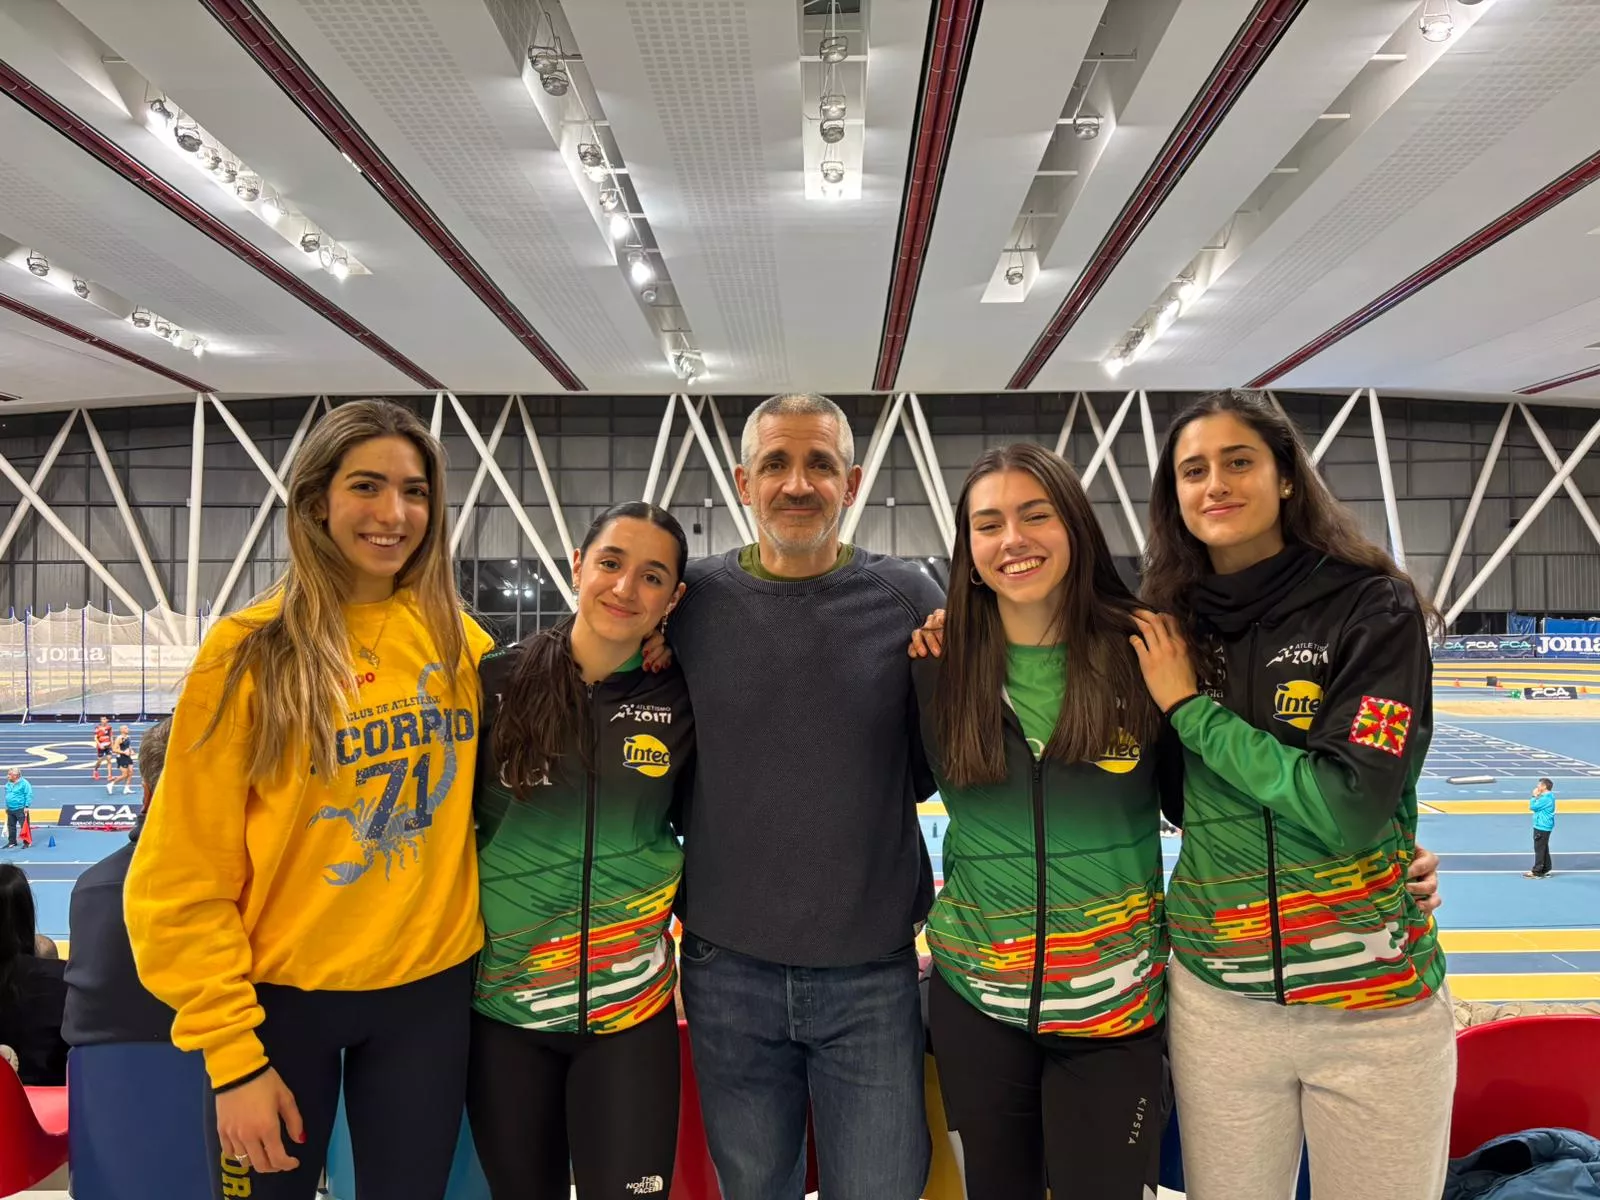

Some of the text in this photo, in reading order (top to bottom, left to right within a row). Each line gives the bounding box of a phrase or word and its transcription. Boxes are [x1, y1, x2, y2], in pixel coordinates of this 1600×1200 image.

[1531, 687, 1570, 696] FCA
[376, 703, 389, 714] DE
[1277, 693, 1322, 713] Inte
[330, 708, 474, 766] CORPIO
[626, 745, 670, 764] Intec
[355, 752, 432, 840] 71
[71, 804, 137, 821] FCA
[1128, 1097, 1148, 1144] KIPSTA
[633, 1187, 654, 1195] FACE
